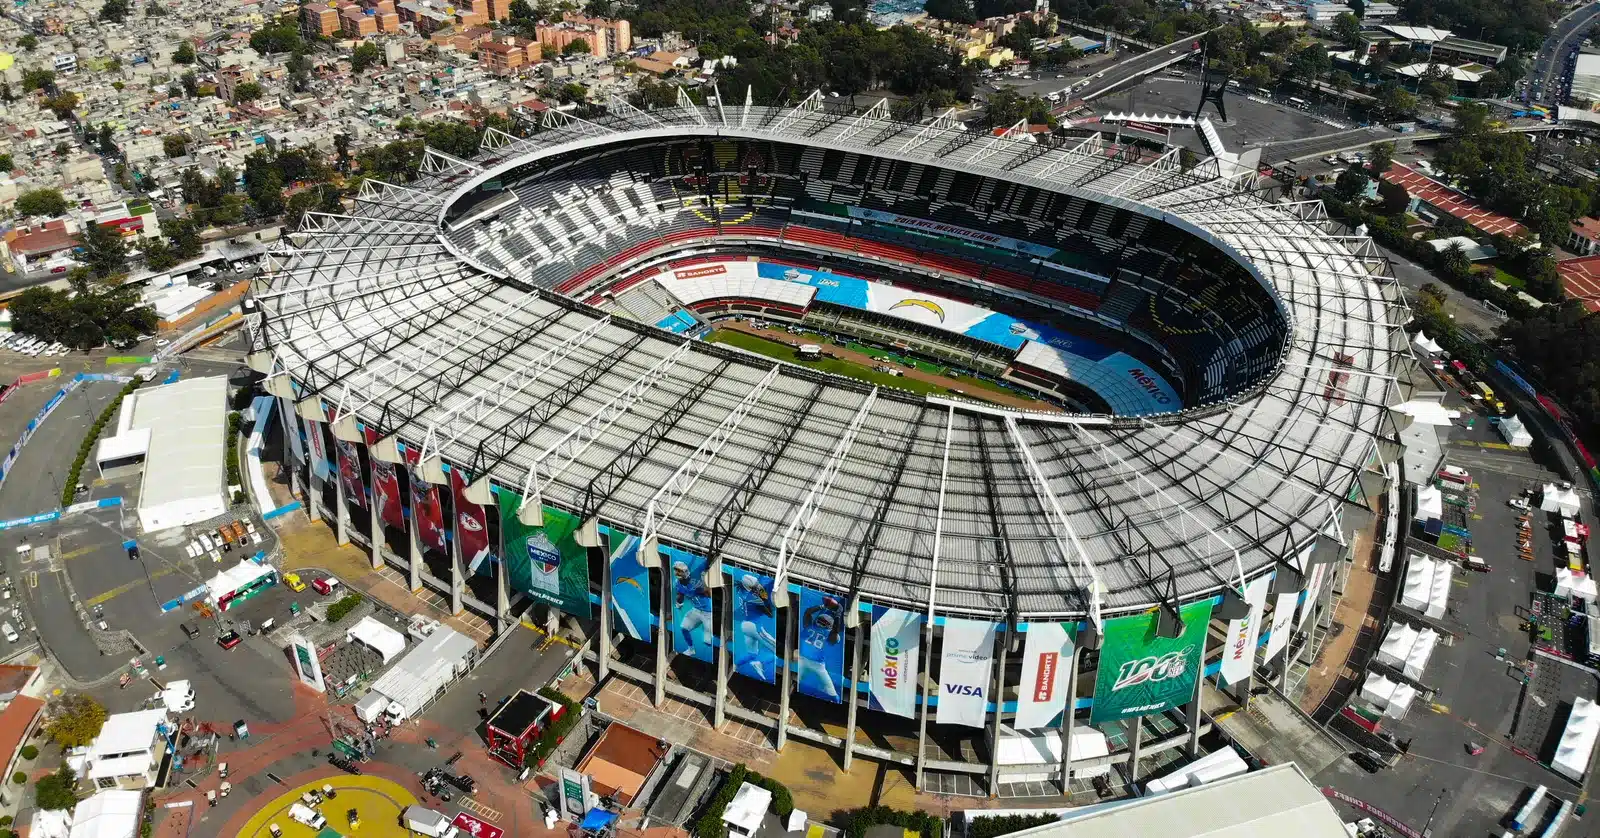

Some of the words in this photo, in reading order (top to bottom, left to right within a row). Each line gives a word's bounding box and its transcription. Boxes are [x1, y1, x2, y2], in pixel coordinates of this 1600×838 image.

[972, 231, 1000, 242] GAME
[687, 266, 725, 277] BANORTE
[530, 547, 557, 561] MEXICO
[1041, 653, 1054, 691] BANORTE
[945, 683, 983, 698] VISA
